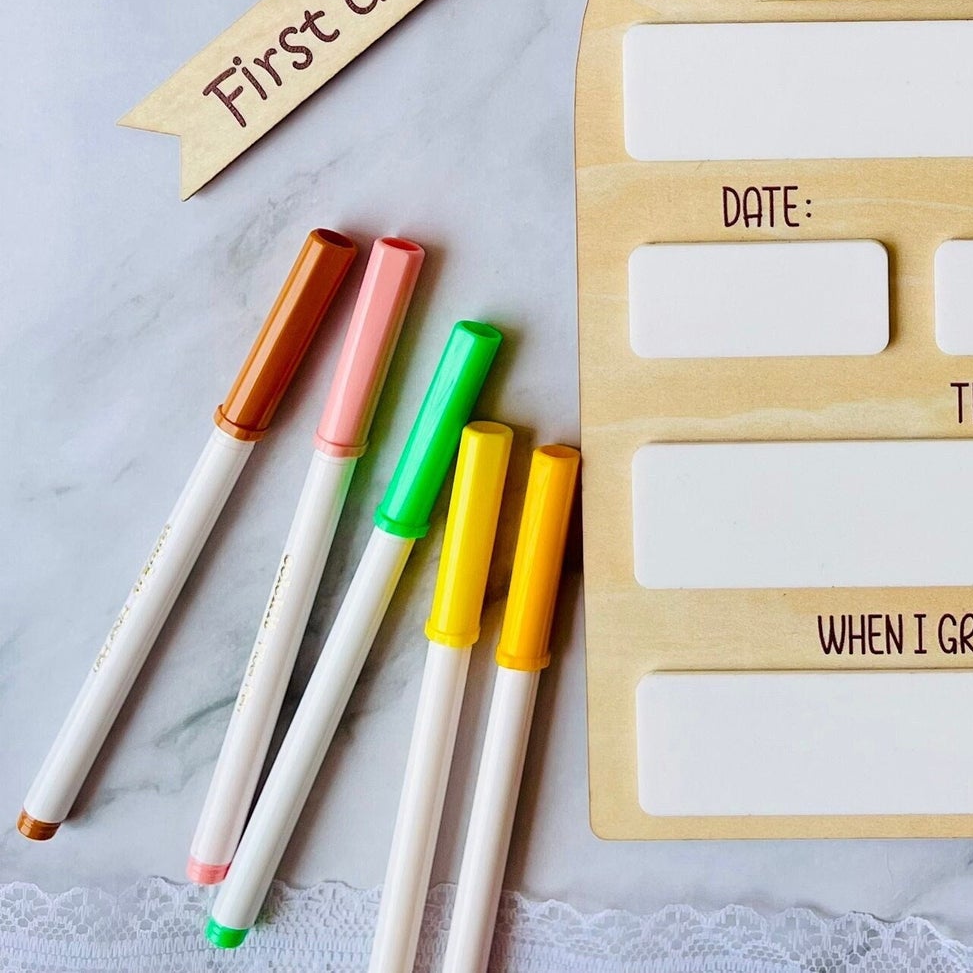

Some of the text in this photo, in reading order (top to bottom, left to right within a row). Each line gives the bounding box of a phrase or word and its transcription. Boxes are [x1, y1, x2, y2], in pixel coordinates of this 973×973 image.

[202, 9, 341, 128] First
[722, 185, 812, 229] DATE:
[817, 613, 904, 655] WHEN
[913, 613, 928, 655] I
